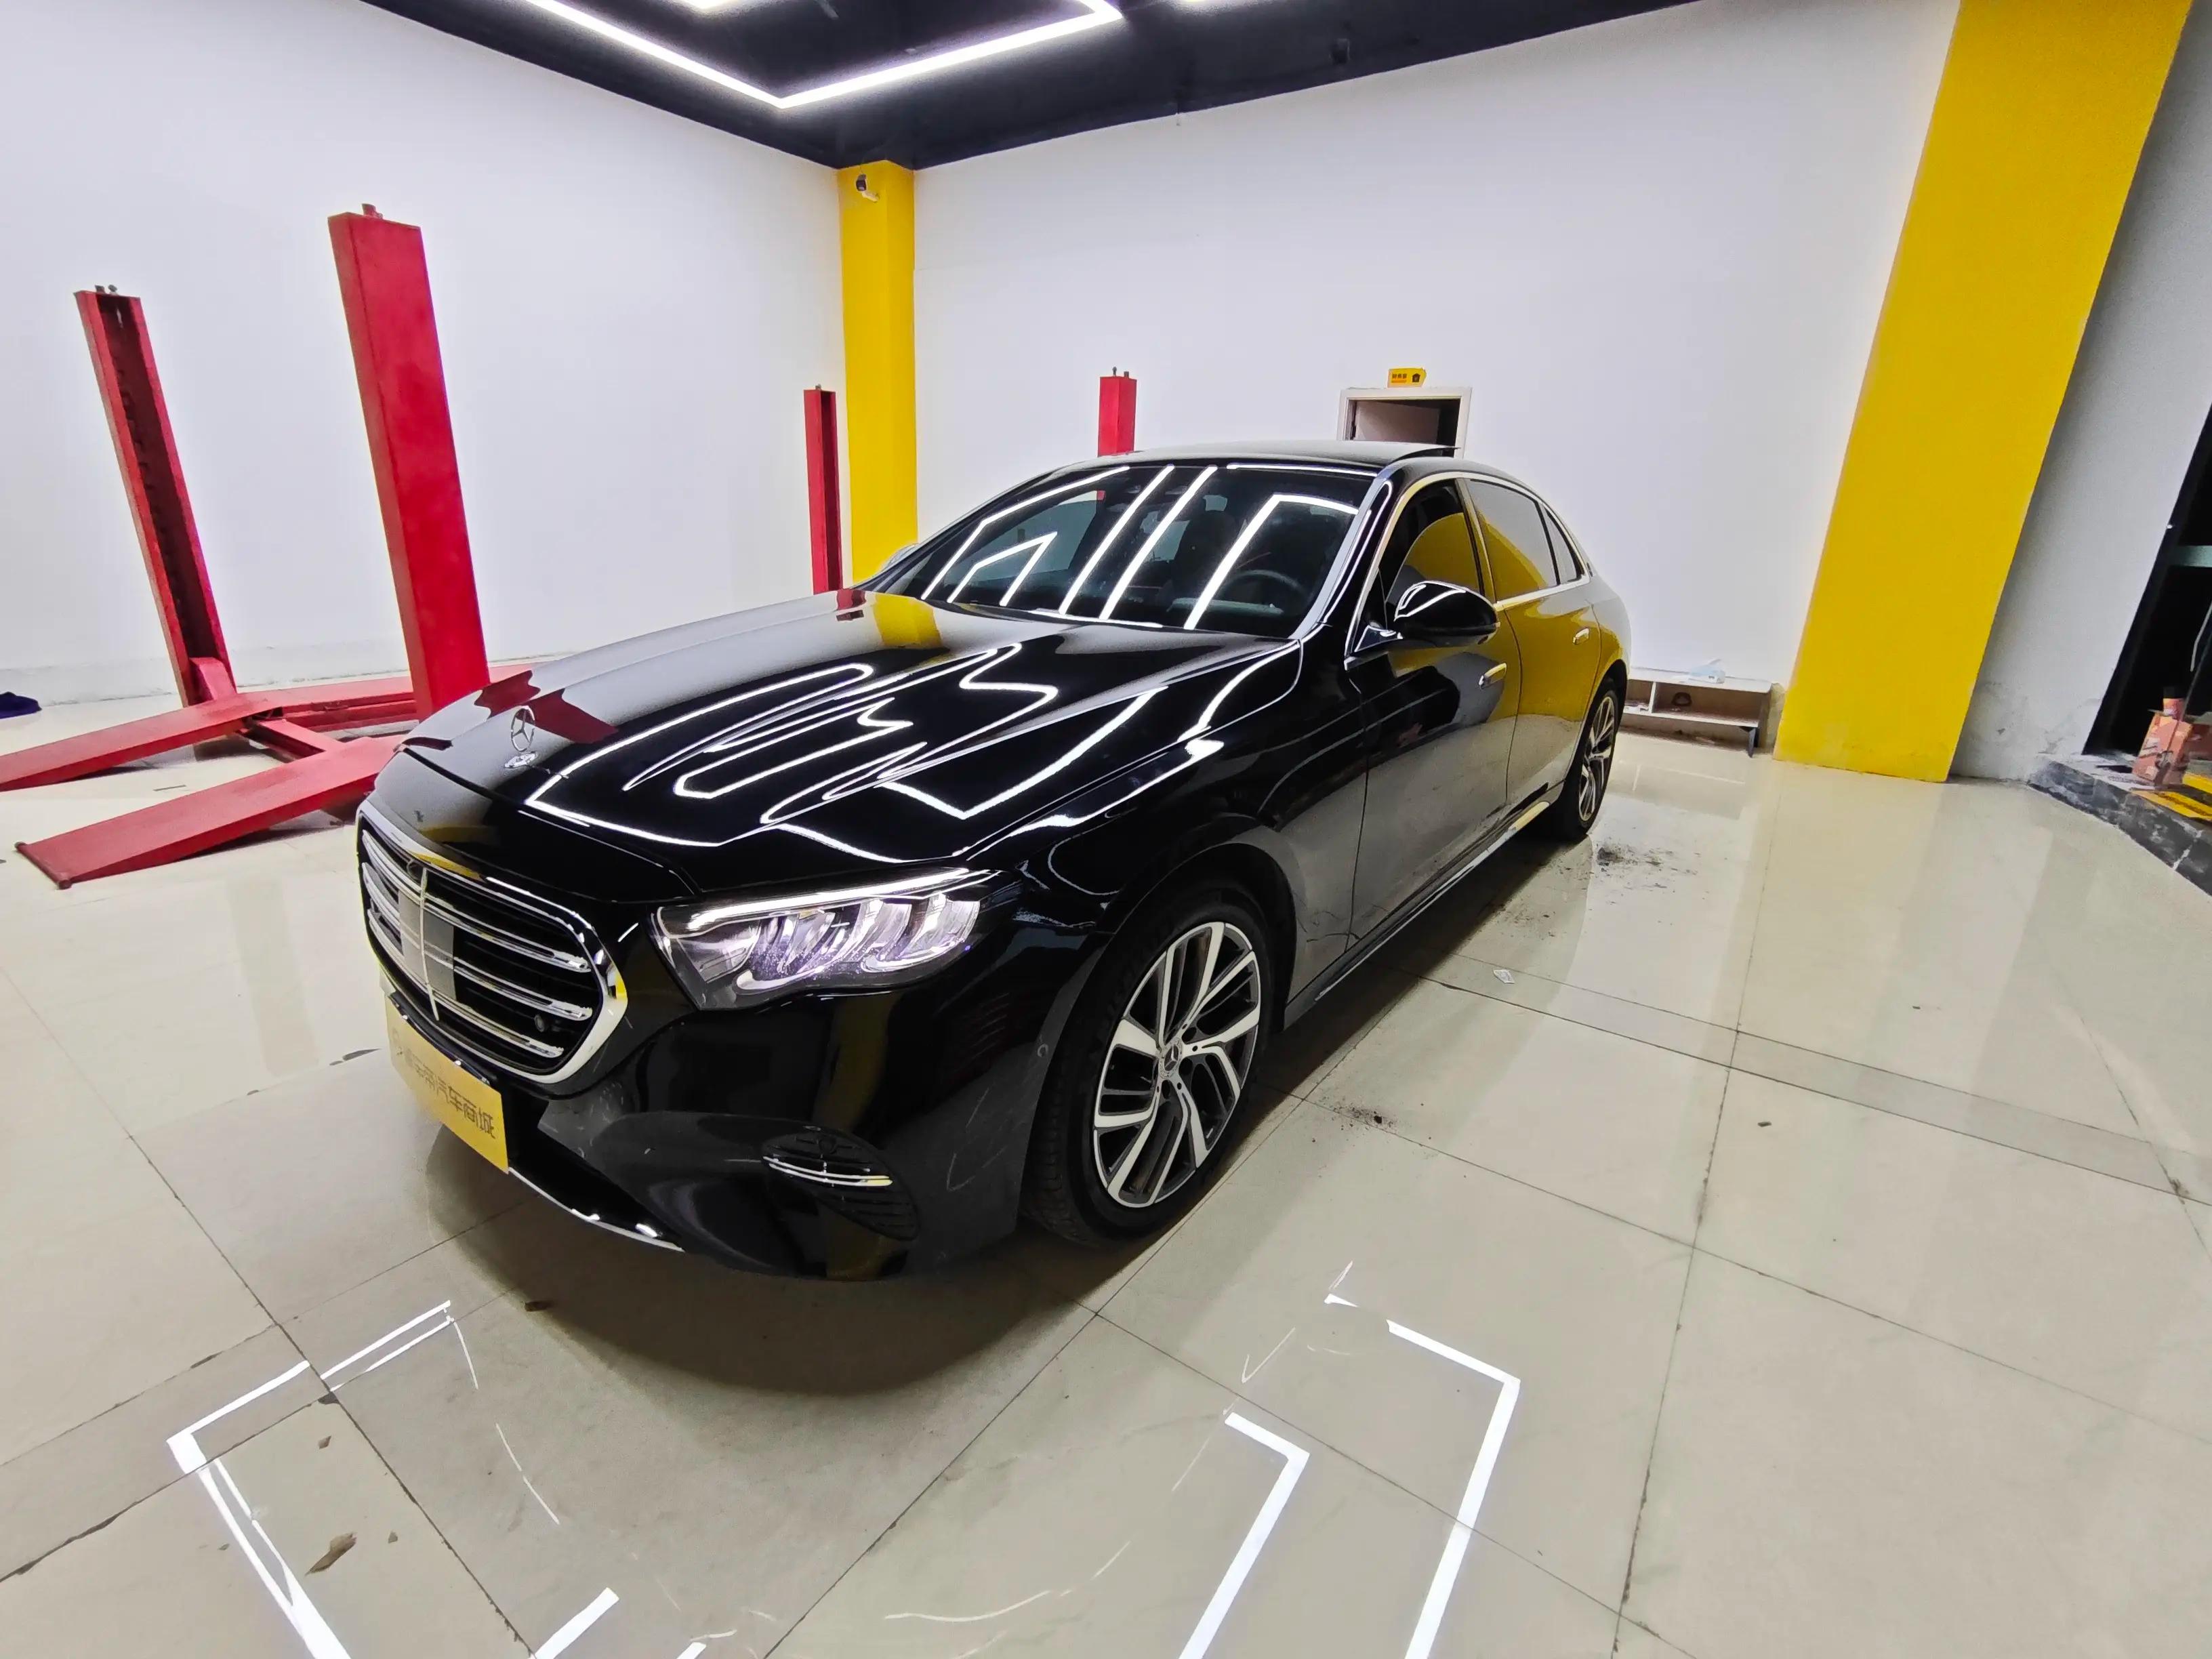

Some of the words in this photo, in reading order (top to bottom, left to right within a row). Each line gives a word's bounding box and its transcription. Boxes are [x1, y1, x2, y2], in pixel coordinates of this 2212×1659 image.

[405, 1048, 496, 1139] 车帝汽车商城
